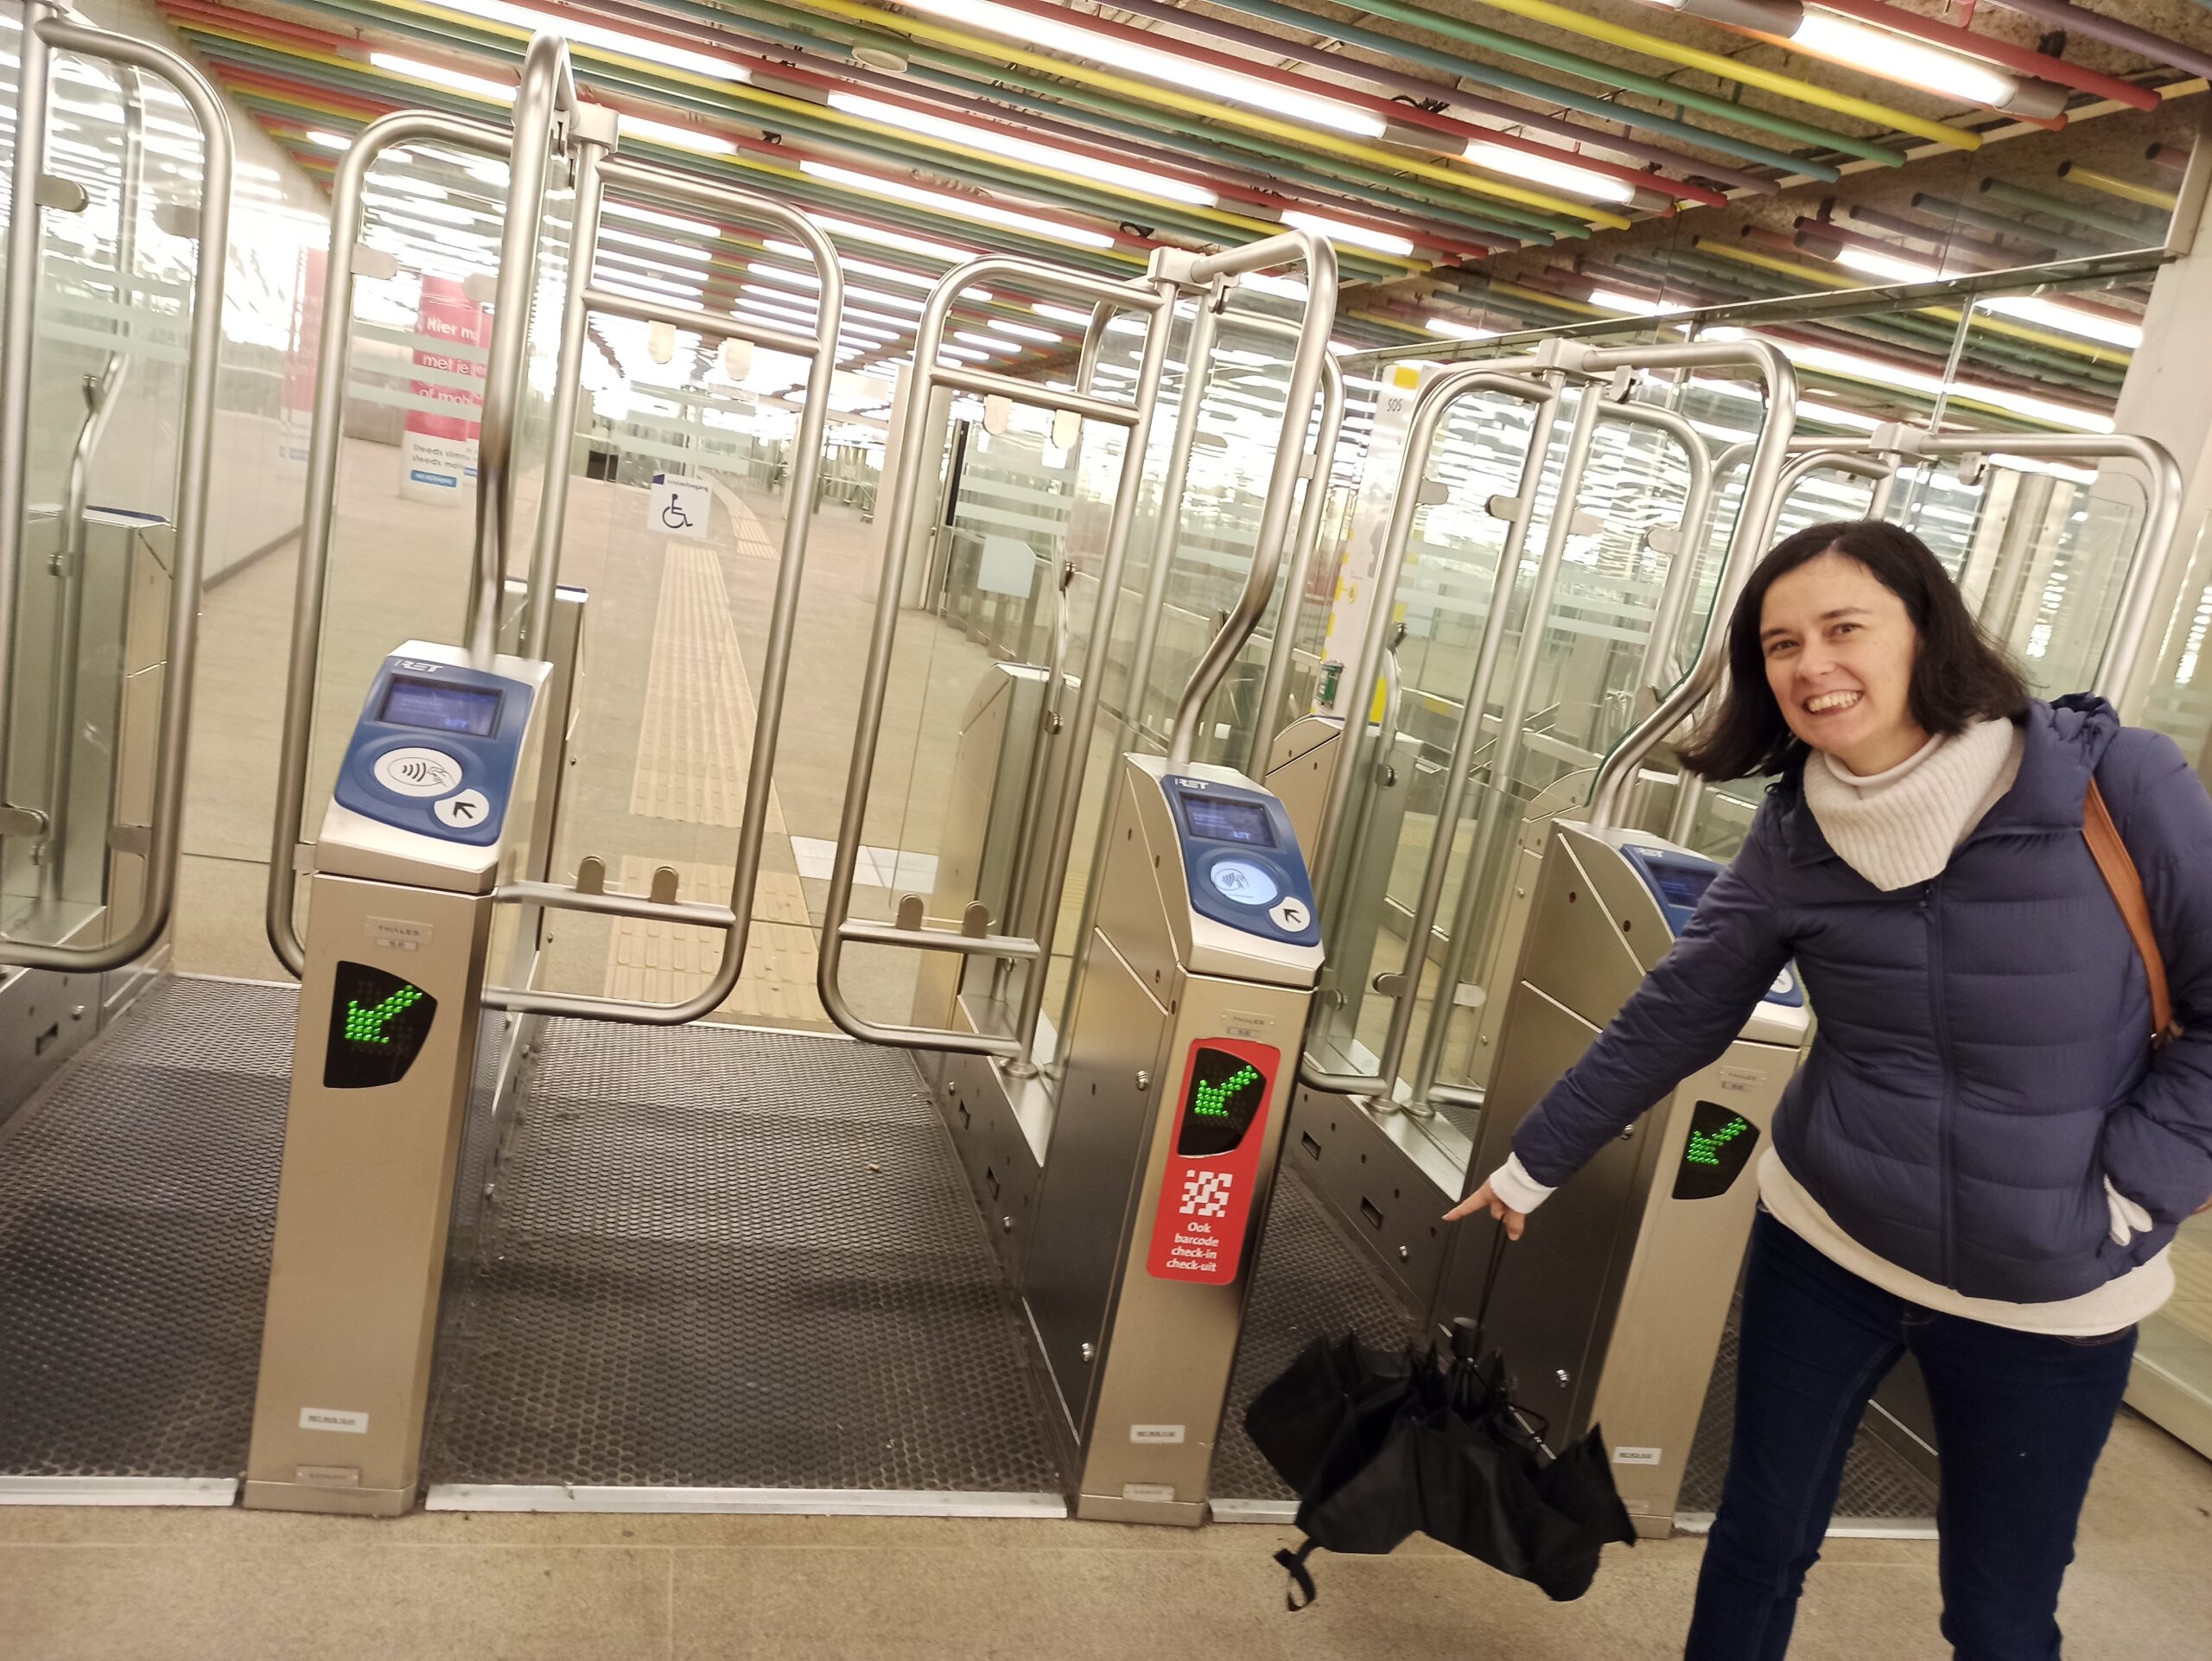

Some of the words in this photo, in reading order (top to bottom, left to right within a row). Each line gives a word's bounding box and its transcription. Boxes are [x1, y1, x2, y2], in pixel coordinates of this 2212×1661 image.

[426, 316, 458, 336] Hier
[1386, 398, 1403, 412] SOS
[394, 659, 445, 673] RET
[1175, 778, 1210, 791] RET
[1187, 1221, 1211, 1234] Ook
[1173, 1232, 1220, 1247] barcode
[1171, 1245, 1217, 1259] check-in
[1166, 1258, 1217, 1272] check-uit
